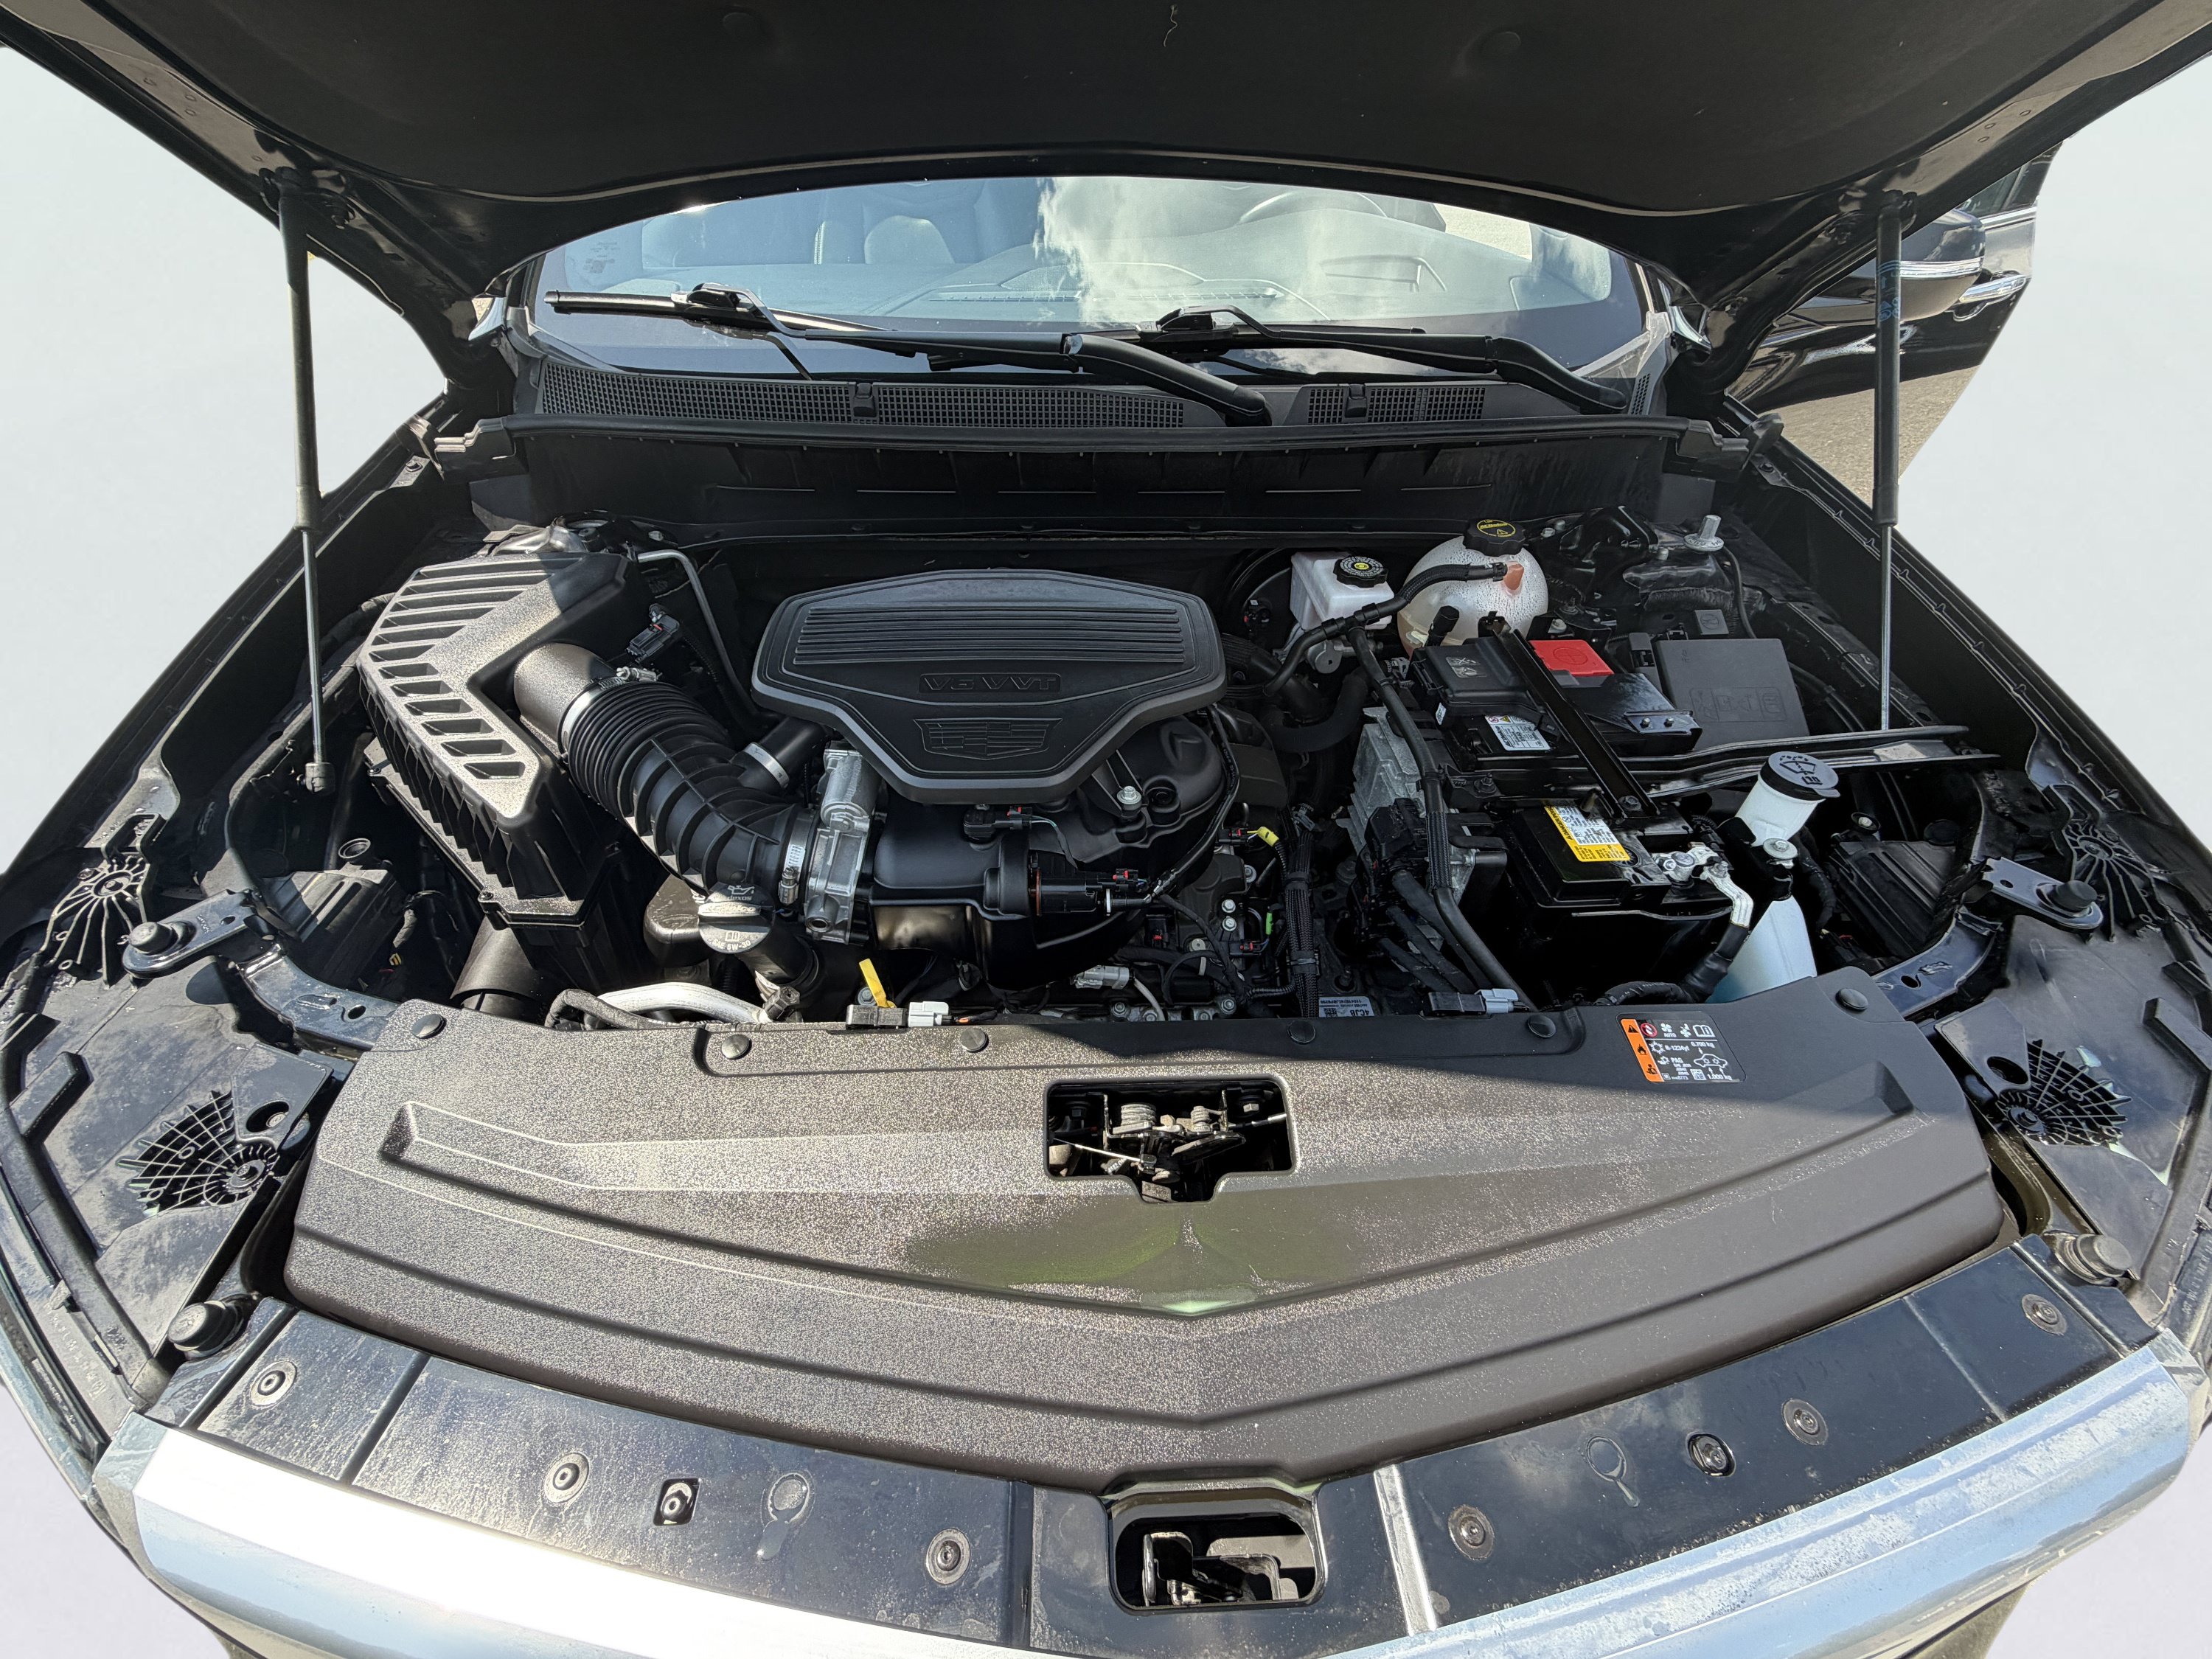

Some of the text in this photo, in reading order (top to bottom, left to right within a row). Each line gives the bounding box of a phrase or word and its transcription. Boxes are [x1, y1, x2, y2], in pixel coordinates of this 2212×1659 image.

[924, 676, 1057, 691] V6 VVT
[712, 939, 751, 950] SAE 5W-30
